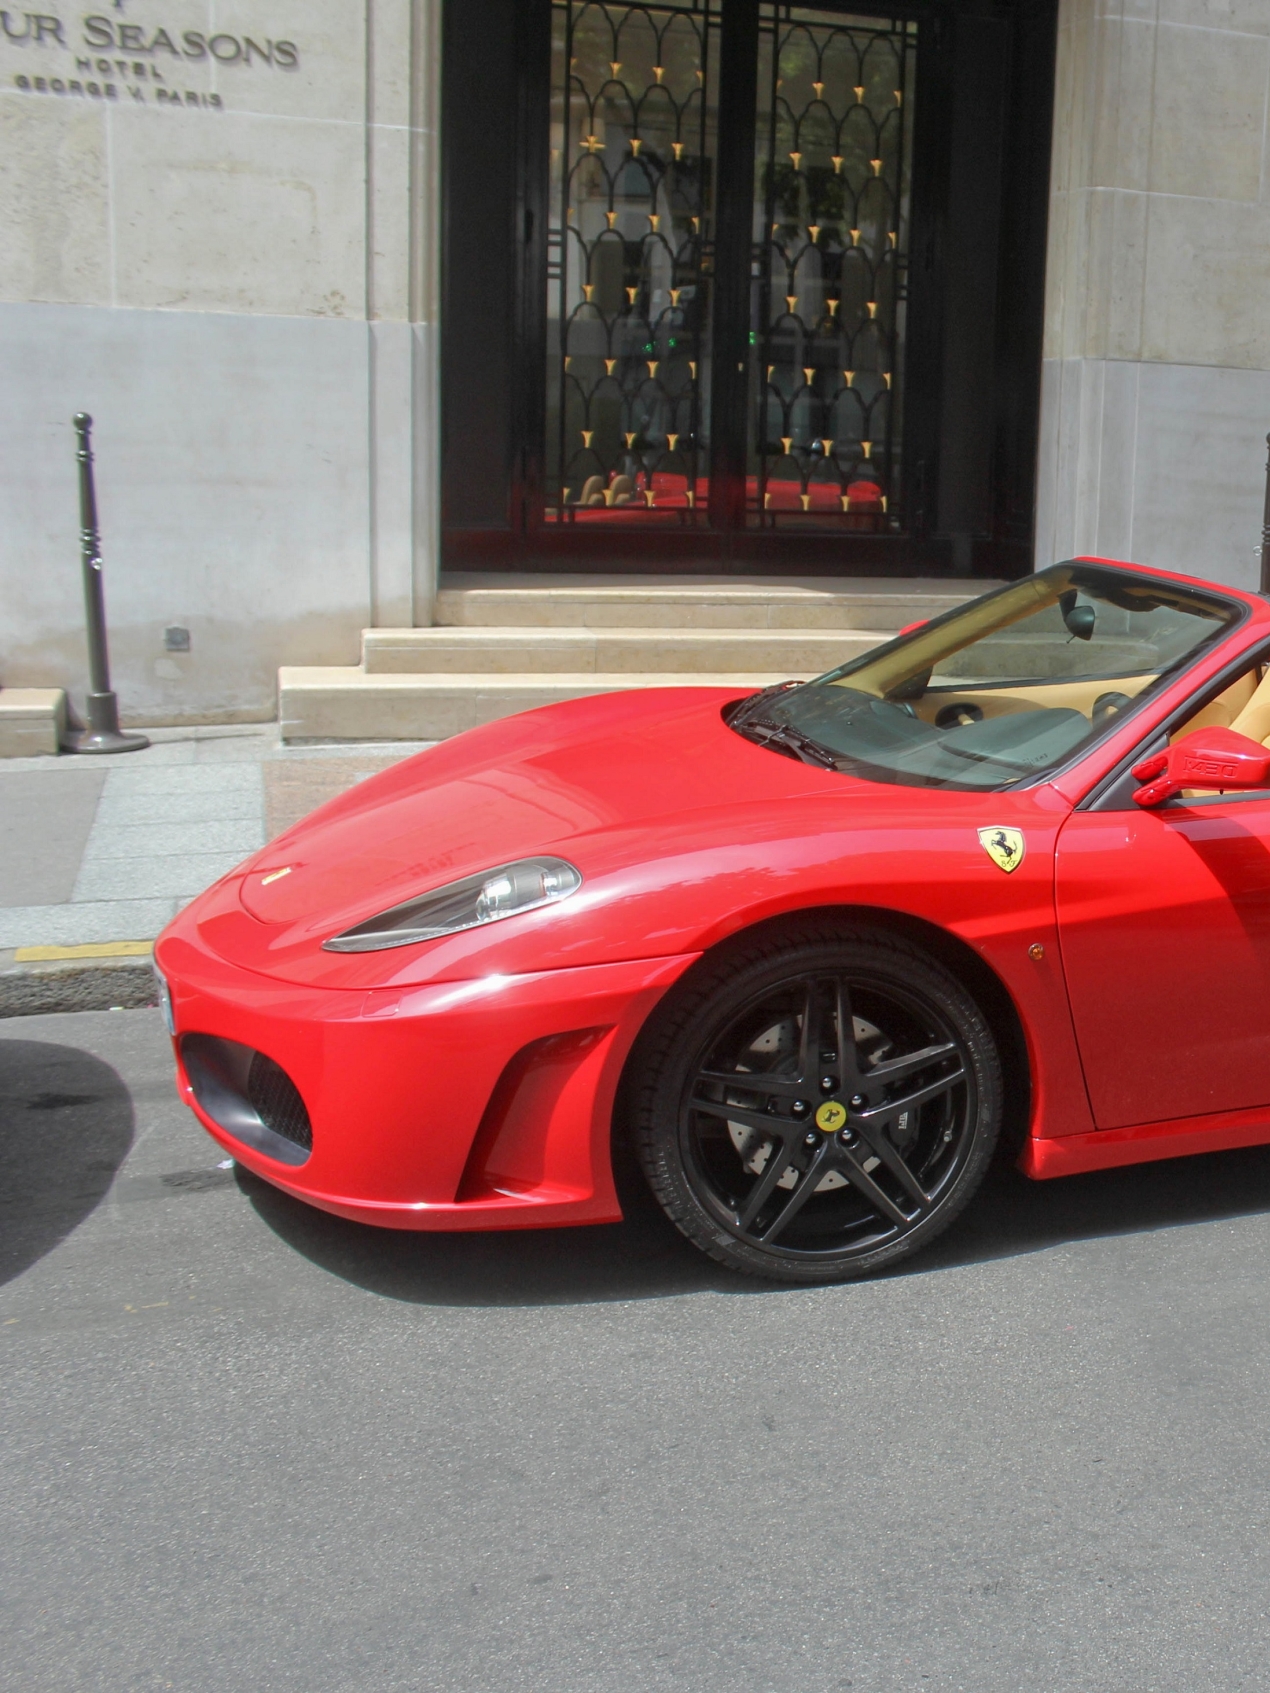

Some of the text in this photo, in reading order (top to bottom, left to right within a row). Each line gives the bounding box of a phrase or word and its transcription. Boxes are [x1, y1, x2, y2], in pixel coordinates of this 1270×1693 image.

[82, 14, 298, 68] SEASONS
[75, 56, 162, 81] HOTEL
[14, 75, 117, 97] GEORGE
[155, 87, 223, 108] PARIS
